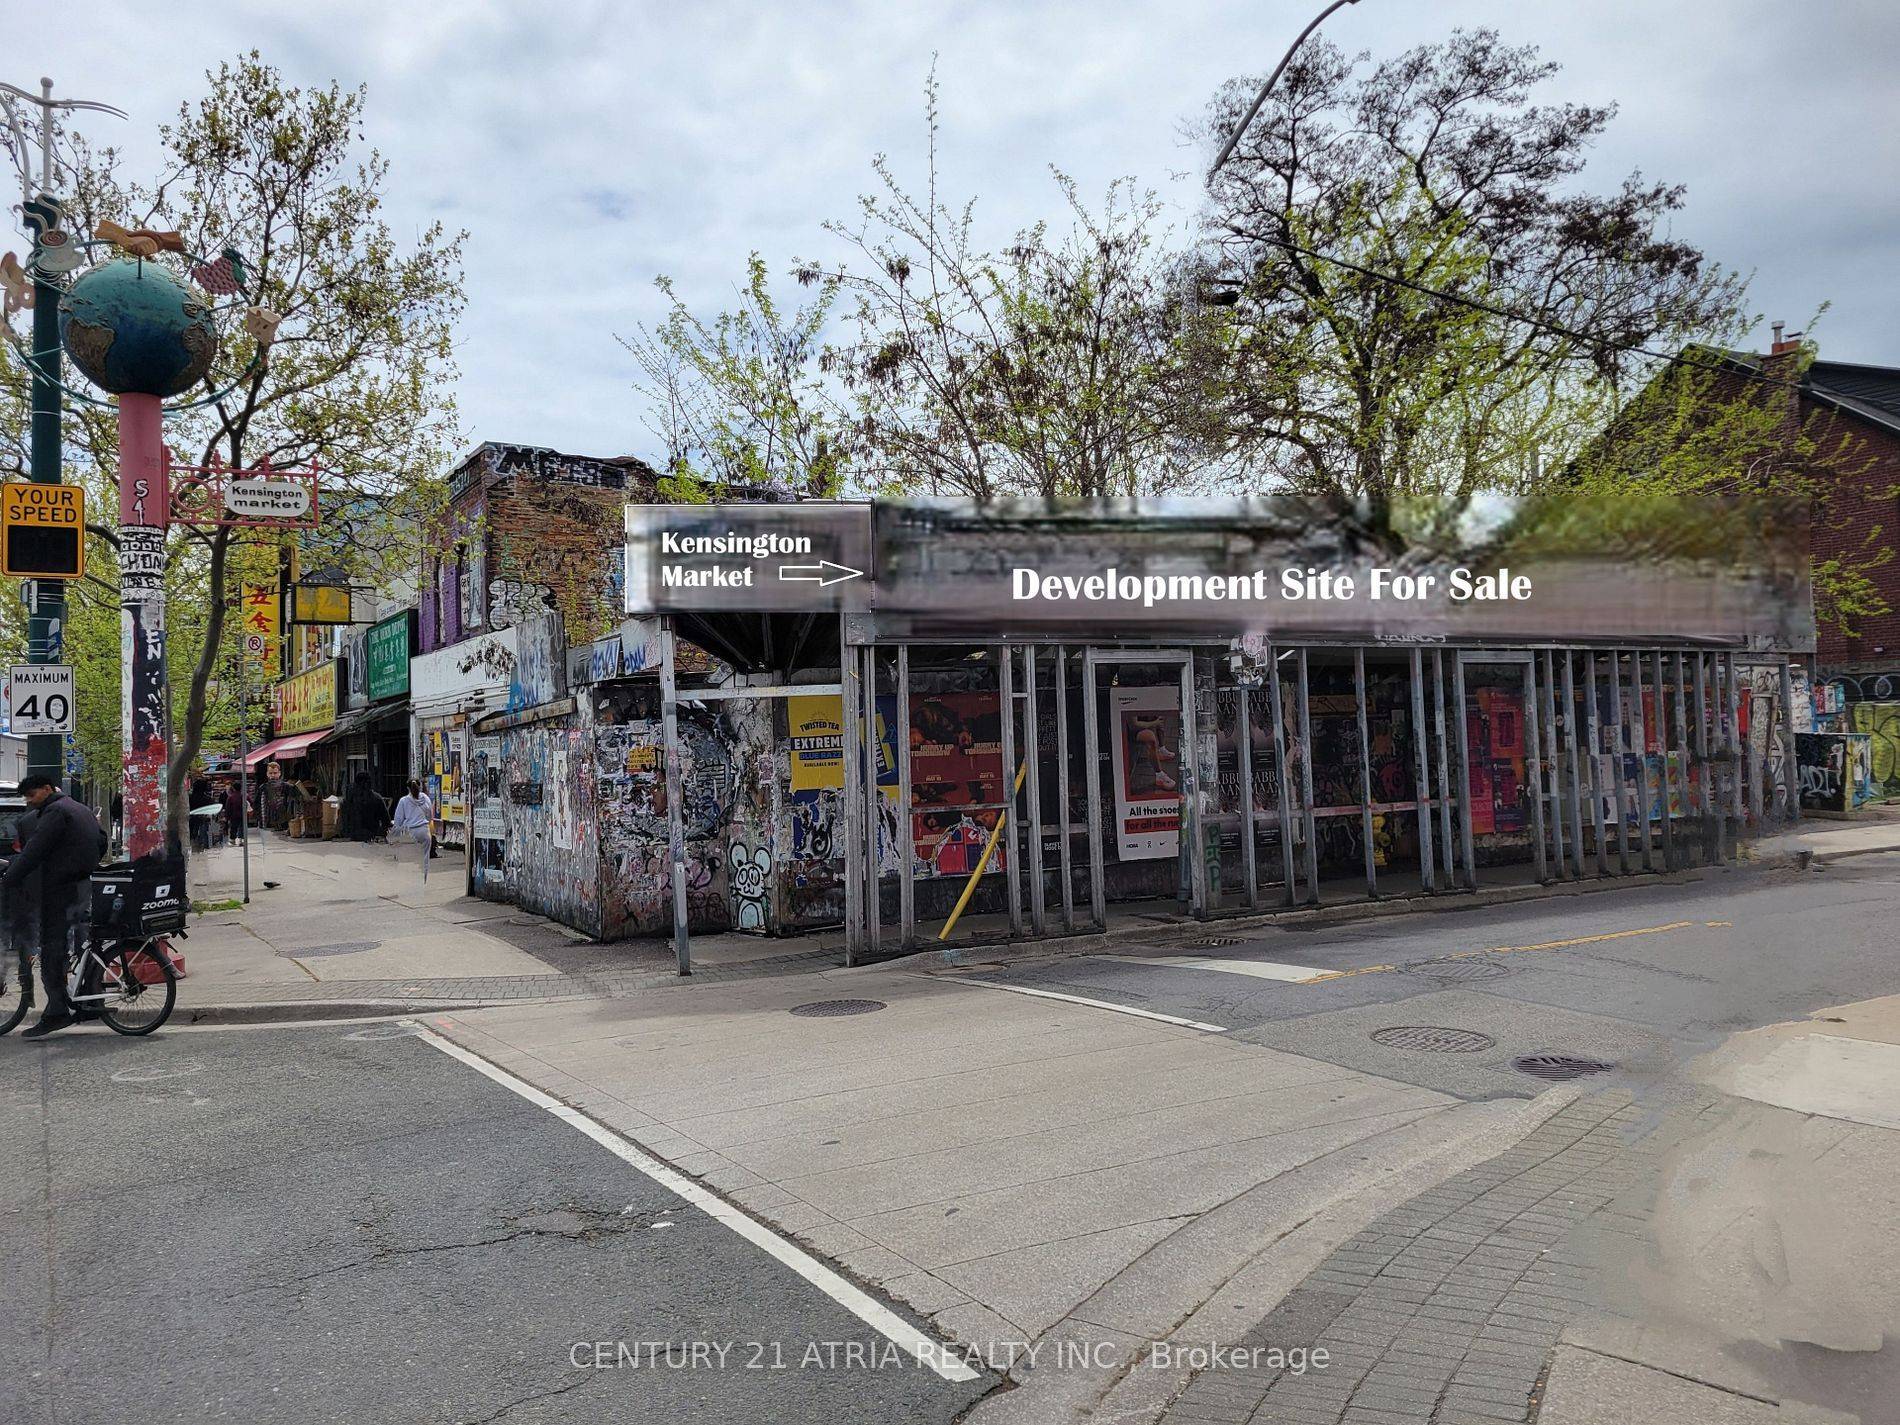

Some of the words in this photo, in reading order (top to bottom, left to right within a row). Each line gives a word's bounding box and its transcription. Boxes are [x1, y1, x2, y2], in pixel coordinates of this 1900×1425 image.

[15, 489, 73, 506] YOUR
[232, 486, 302, 499] Kensington
[234, 500, 301, 509] market
[10, 506, 77, 523] SPEED
[15, 672, 69, 684] MAXIMUM
[15, 694, 69, 724] 40
[800, 721, 827, 732] TWISTED
[828, 721, 840, 731] TEA
[1130, 806, 1141, 816] All
[1143, 806, 1158, 815] the
[1127, 821, 1139, 830] for
[1140, 820, 1152, 829] all
